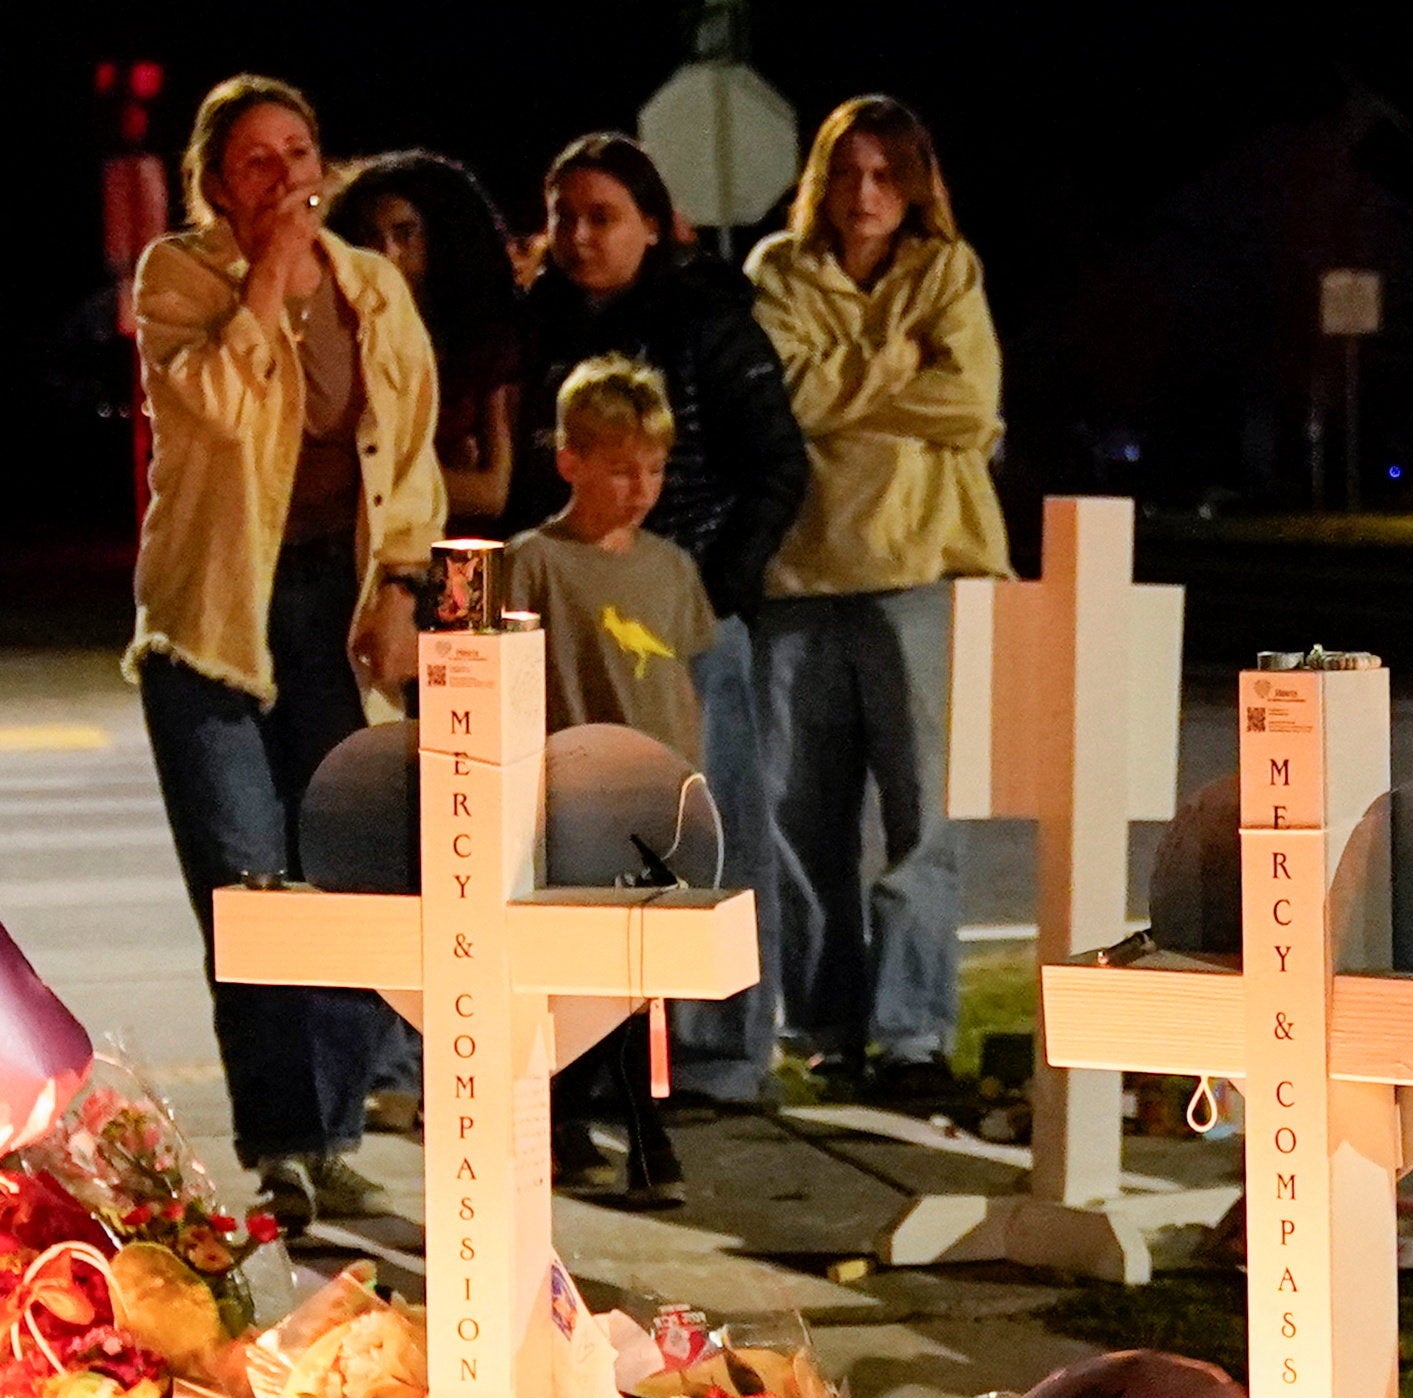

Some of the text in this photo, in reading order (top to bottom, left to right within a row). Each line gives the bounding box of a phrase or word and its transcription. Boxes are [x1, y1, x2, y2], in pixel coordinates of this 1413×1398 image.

[450, 710, 472, 899] MERCY
[1270, 758, 1292, 972] MERCY
[453, 932, 475, 959] &
[1274, 1011, 1294, 1041] &
[454, 994, 480, 1381] COMPASSION
